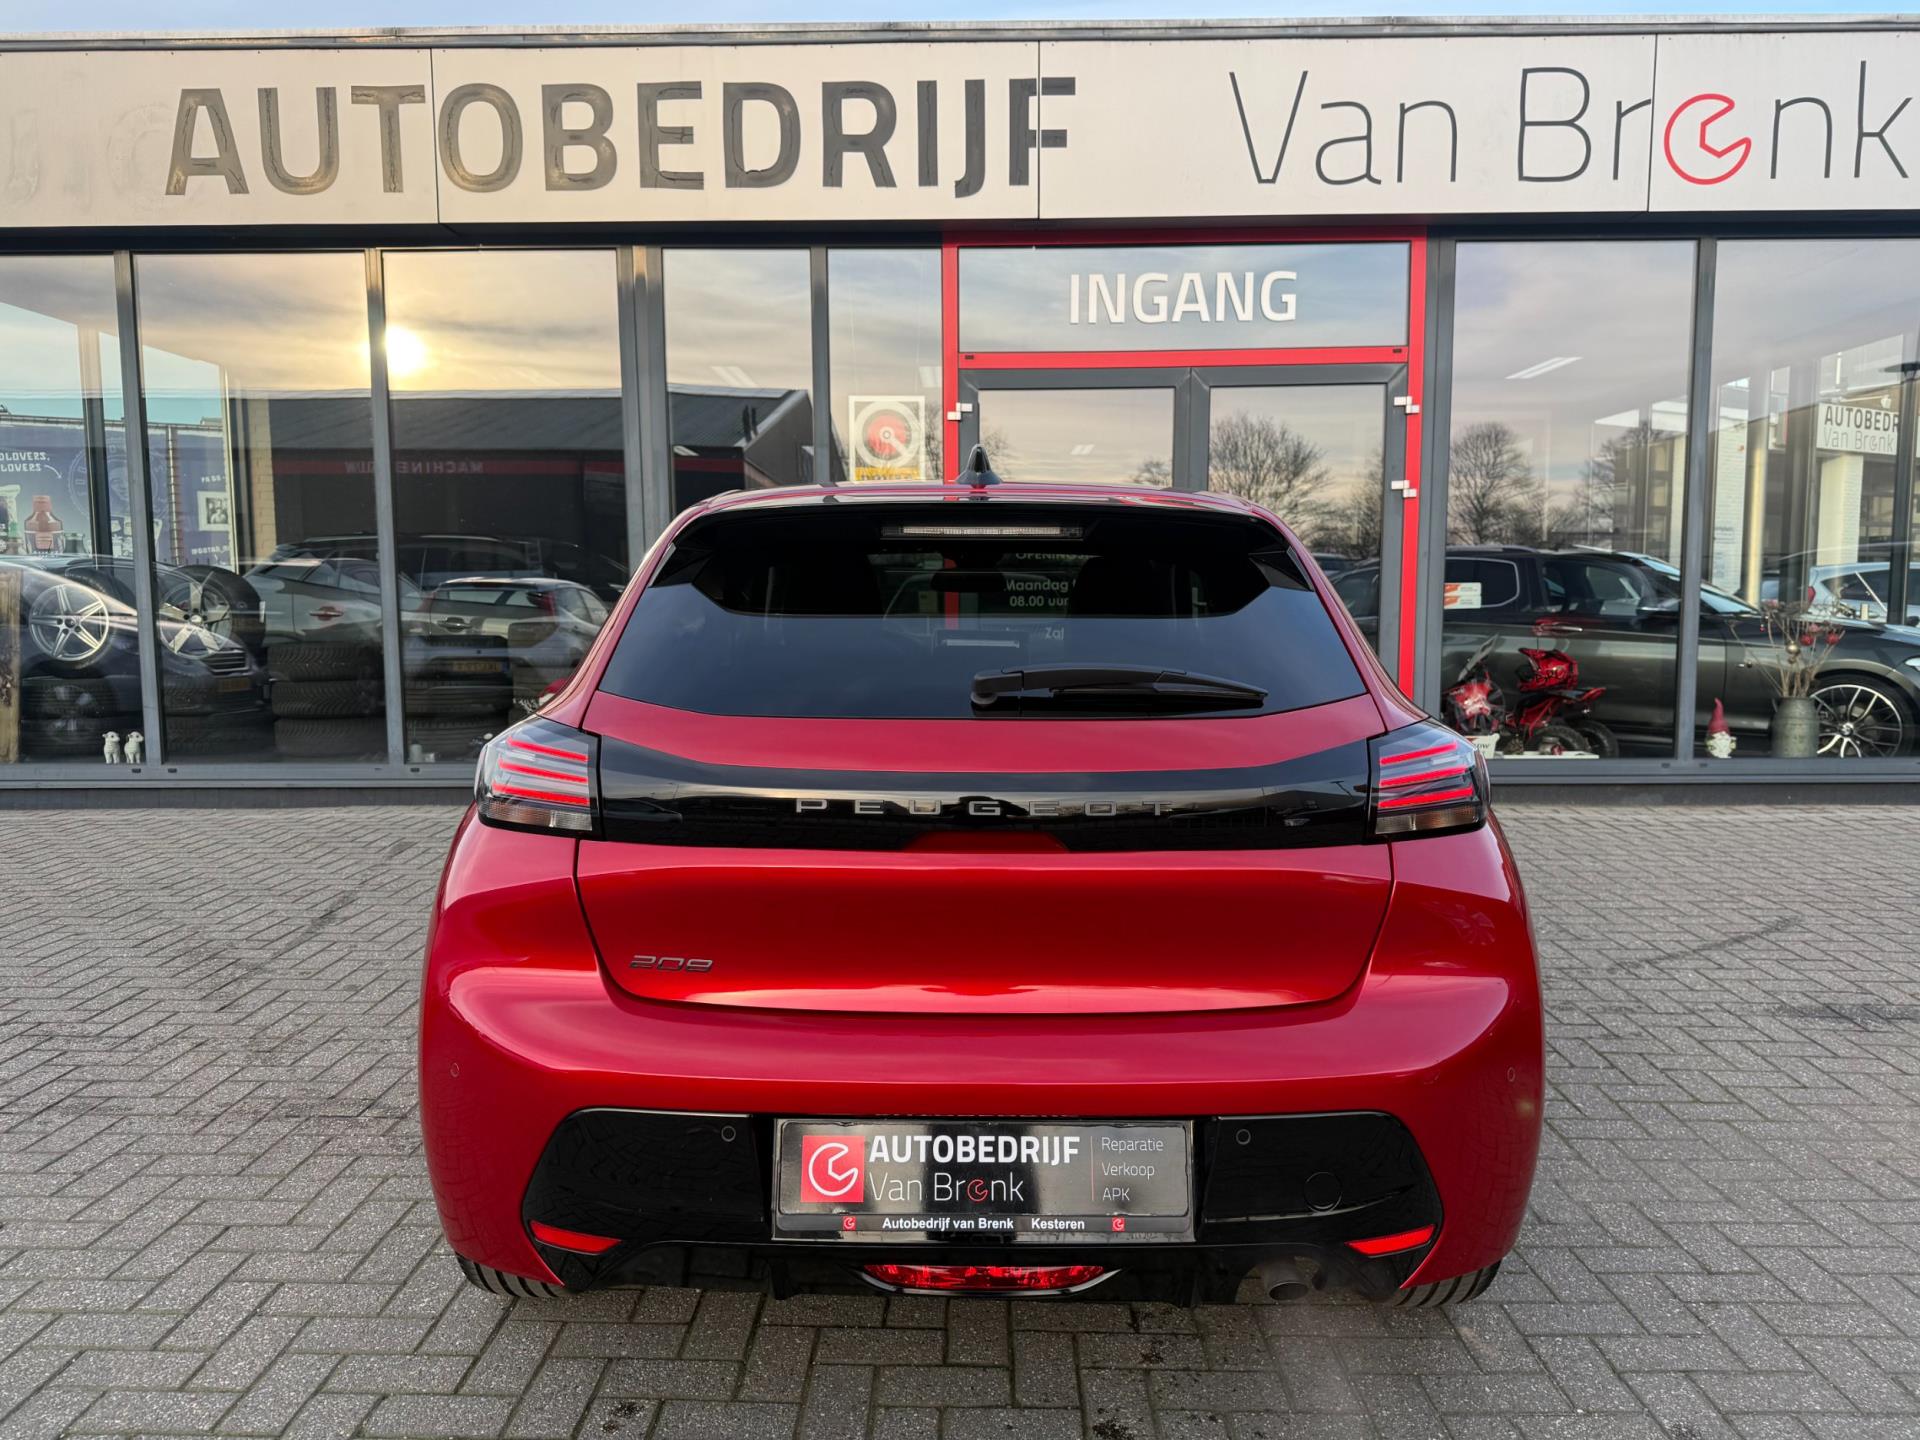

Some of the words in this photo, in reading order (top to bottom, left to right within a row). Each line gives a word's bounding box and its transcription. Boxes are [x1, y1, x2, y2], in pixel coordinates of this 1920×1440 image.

[165, 77, 1076, 198] AUTOBEDRIJF
[1228, 70, 1458, 185] Van
[1070, 270, 1299, 325] INGANG
[1824, 405, 1899, 432] AUTOBEDR
[1823, 427, 1849, 448] Van
[1009, 595, 1044, 607] 08.00
[1047, 597, 1069, 607] uur
[795, 799, 1172, 817] PEUGEOT
[629, 954, 714, 972] 208
[868, 1134, 1081, 1166] AUTOBEDRIJF
[1101, 1136, 1164, 1154] Reparatie
[1101, 1162, 1155, 1181] Verkoop
[869, 1172, 923, 1201] Van
[1102, 1187, 1130, 1201] APK
[882, 1217, 951, 1232] Autobedrijf
[952, 1220, 976, 1230] van
[978, 1217, 1014, 1230] Brenk
[1031, 1217, 1085, 1230] Kesteren
